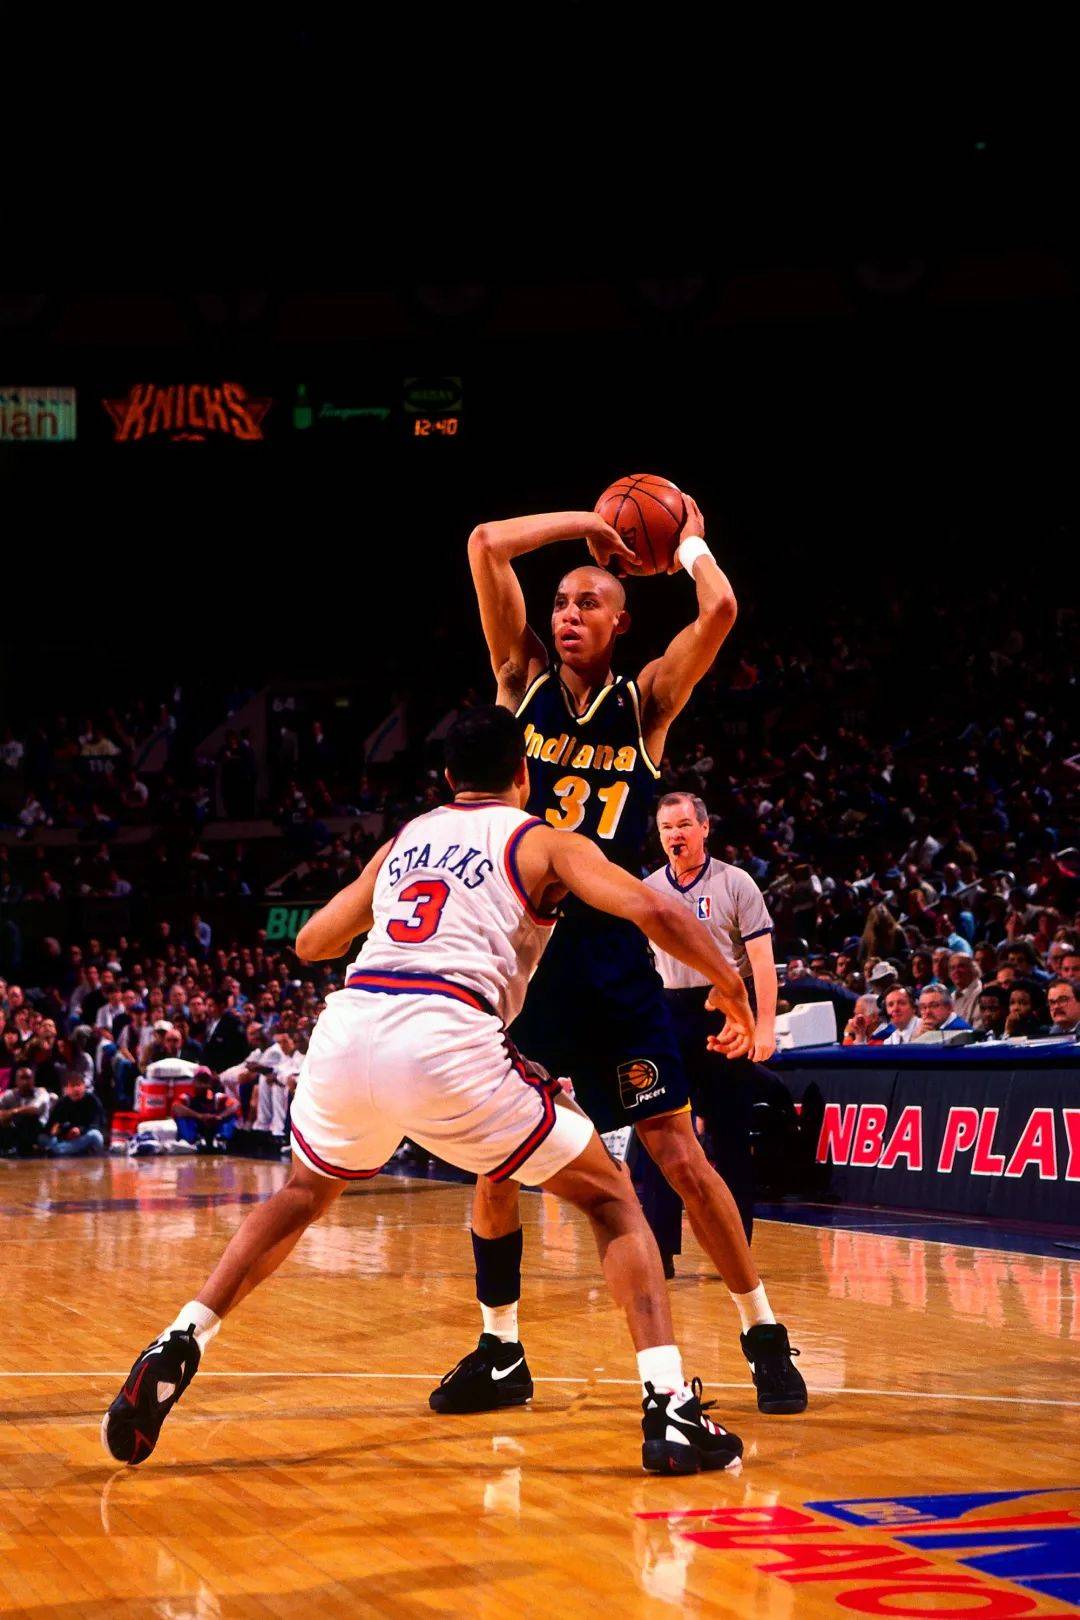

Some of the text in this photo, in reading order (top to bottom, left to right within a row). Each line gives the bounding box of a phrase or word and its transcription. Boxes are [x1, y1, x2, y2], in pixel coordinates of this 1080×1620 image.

[112, 383, 263, 442] KNICKS
[524, 723, 637, 771] Indiana
[545, 775, 630, 839] 31
[388, 843, 493, 889] STARKS
[386, 879, 450, 943] 3
[815, 1103, 922, 1171] NBA
[634, 1505, 1080, 1620] PLAYO
